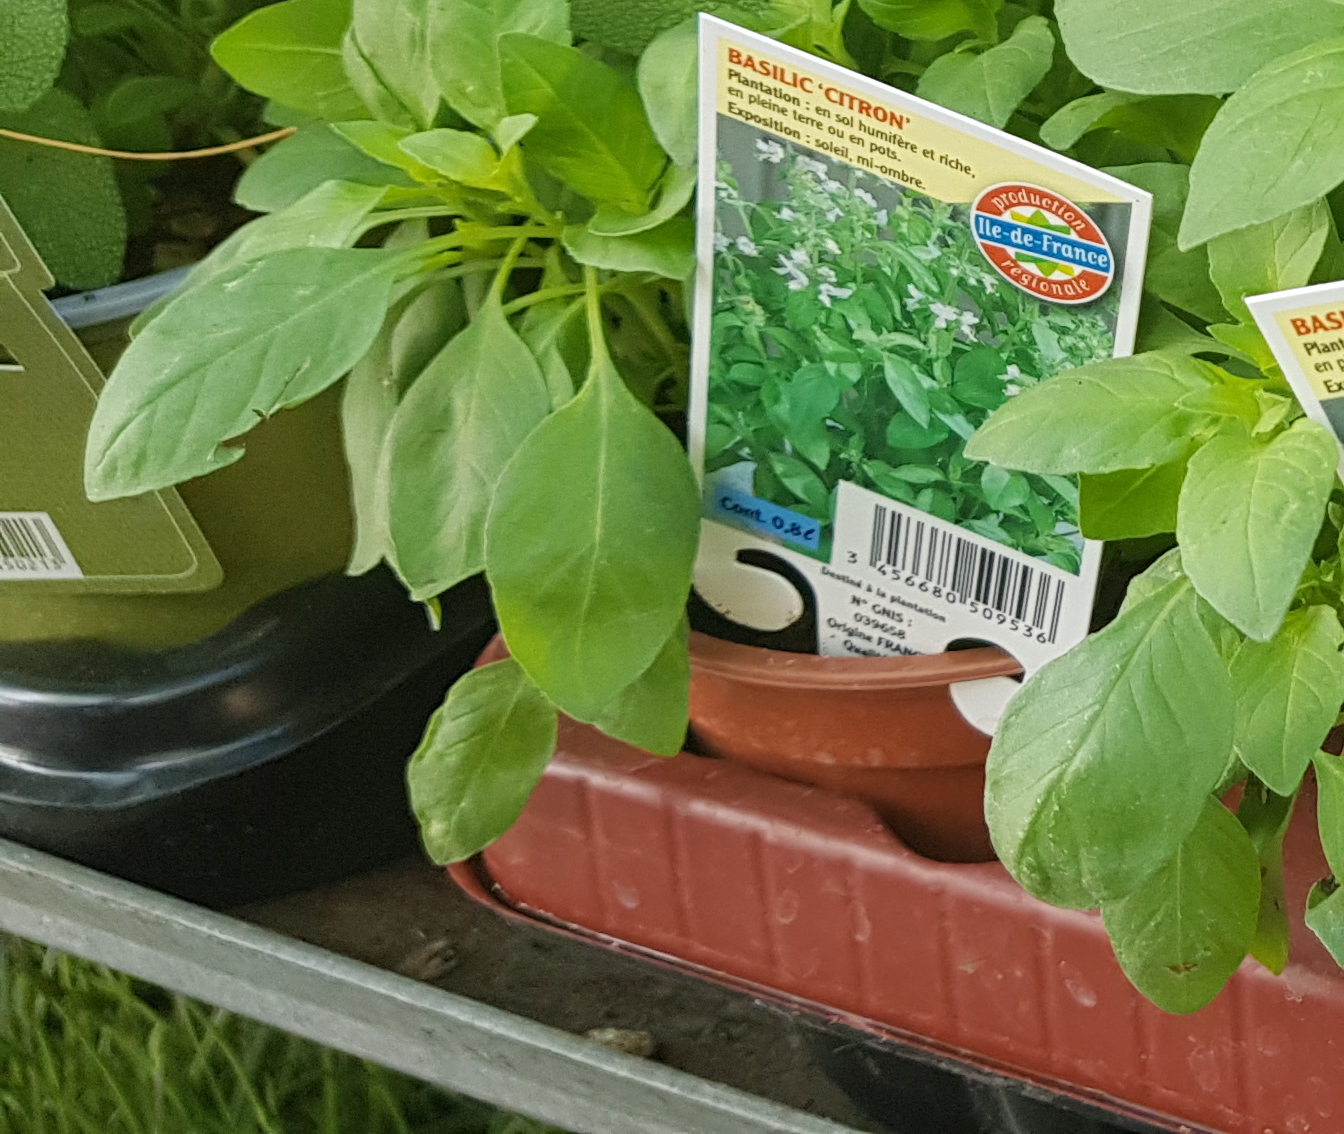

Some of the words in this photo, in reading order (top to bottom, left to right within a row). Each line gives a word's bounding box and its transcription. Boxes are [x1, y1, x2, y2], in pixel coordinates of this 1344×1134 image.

[728, 47, 814, 94] BASILIC
[728, 68, 801, 107] Plantation
[815, 105, 831, 119] en
[835, 113, 854, 128] sol
[858, 119, 918, 154] humifère
[922, 147, 936, 162] et
[939, 153, 976, 179] riche,
[728, 86, 744, 100] en
[748, 93, 789, 117] pleine
[792, 109, 824, 131] terre
[827, 125, 845, 139] ou
[849, 133, 865, 148] en
[869, 141, 902, 162] pots.
[728, 101, 801, 140] Exposition
[814, 138, 853, 162] soleil,
[856, 154, 927, 191] mi-ombre.
[991, 188, 1086, 231] production
[977, 216, 1109, 267] Ile-de-France
[1314, 360, 1334, 373] en
[847, 550, 858, 564] 3
[877, 564, 957, 604] 456680
[969, 601, 1047, 644] 509536
[876, 587, 887, 598] la
[889, 594, 947, 623] plantation
[826, 617, 873, 642] Origine
